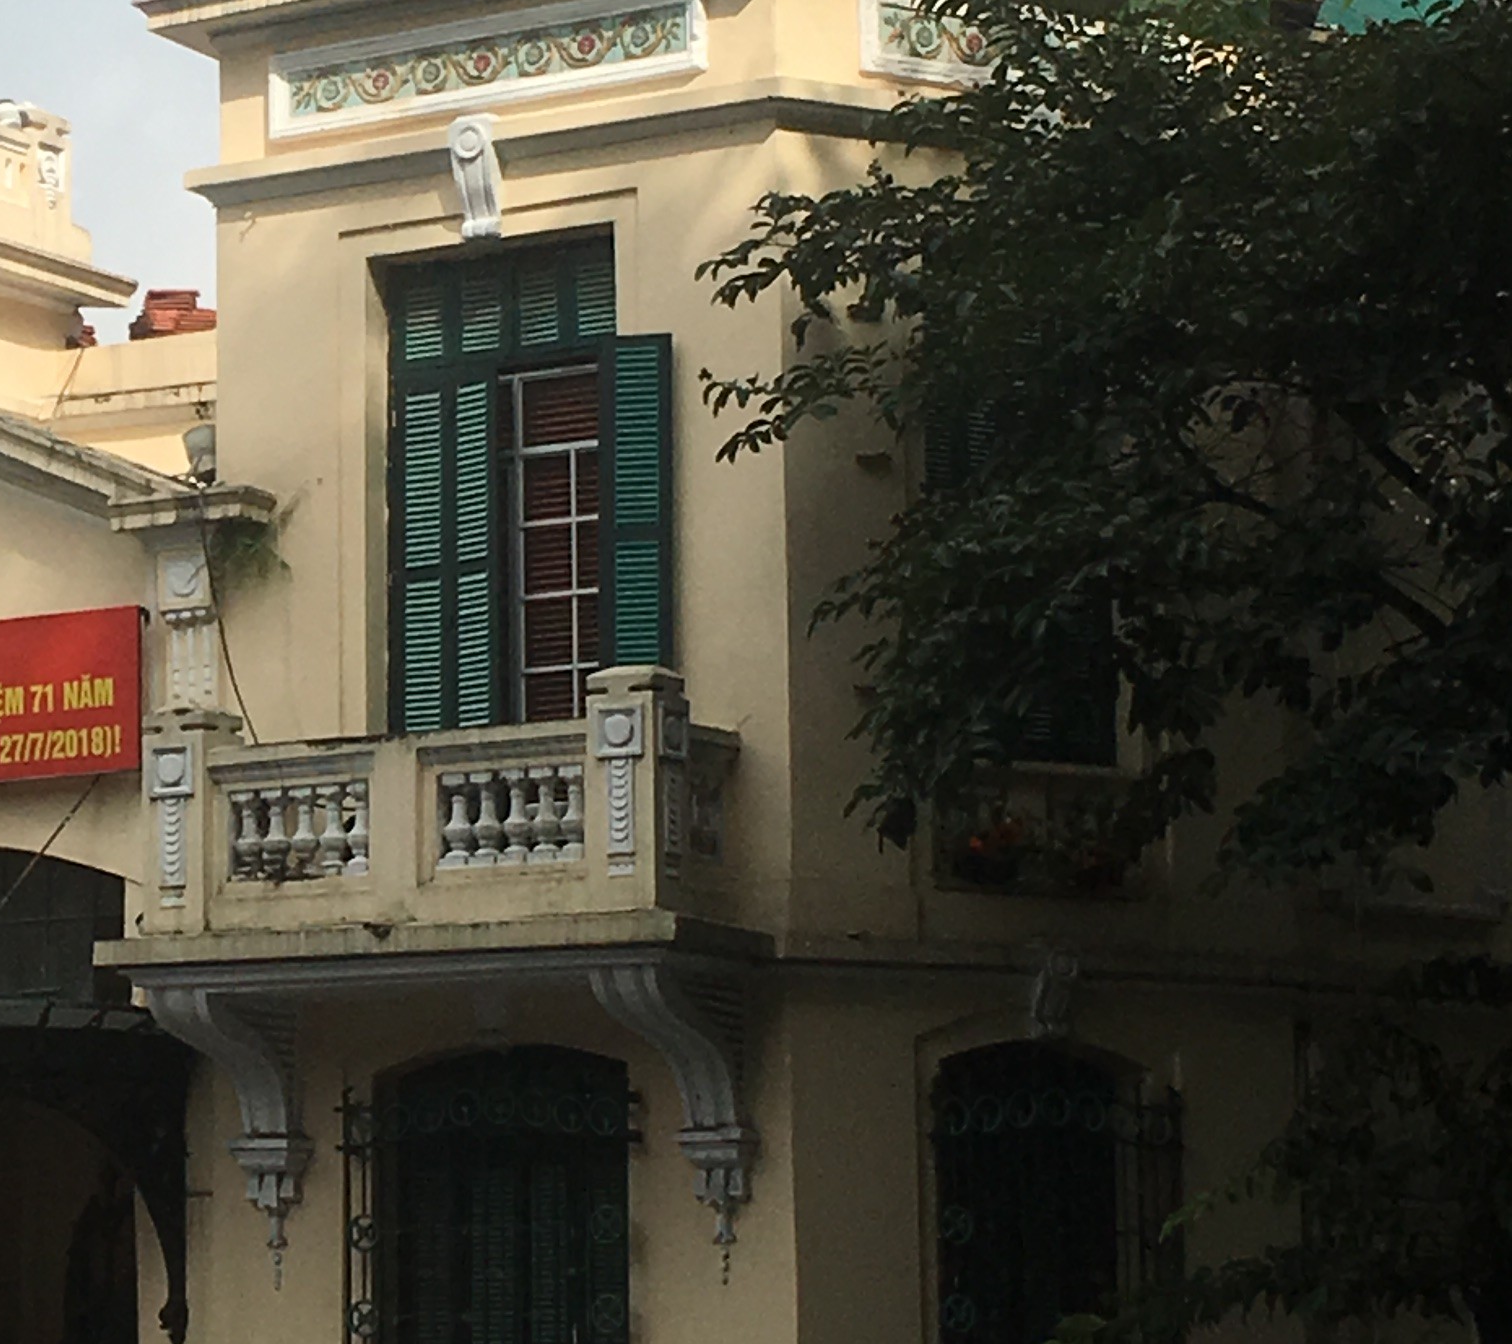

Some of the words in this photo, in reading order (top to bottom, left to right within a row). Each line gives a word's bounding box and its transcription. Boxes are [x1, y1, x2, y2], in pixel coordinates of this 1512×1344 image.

[30, 684, 54, 713] 71
[63, 674, 115, 711] NĂM
[0, 725, 121, 764] 27/7/2018)!
